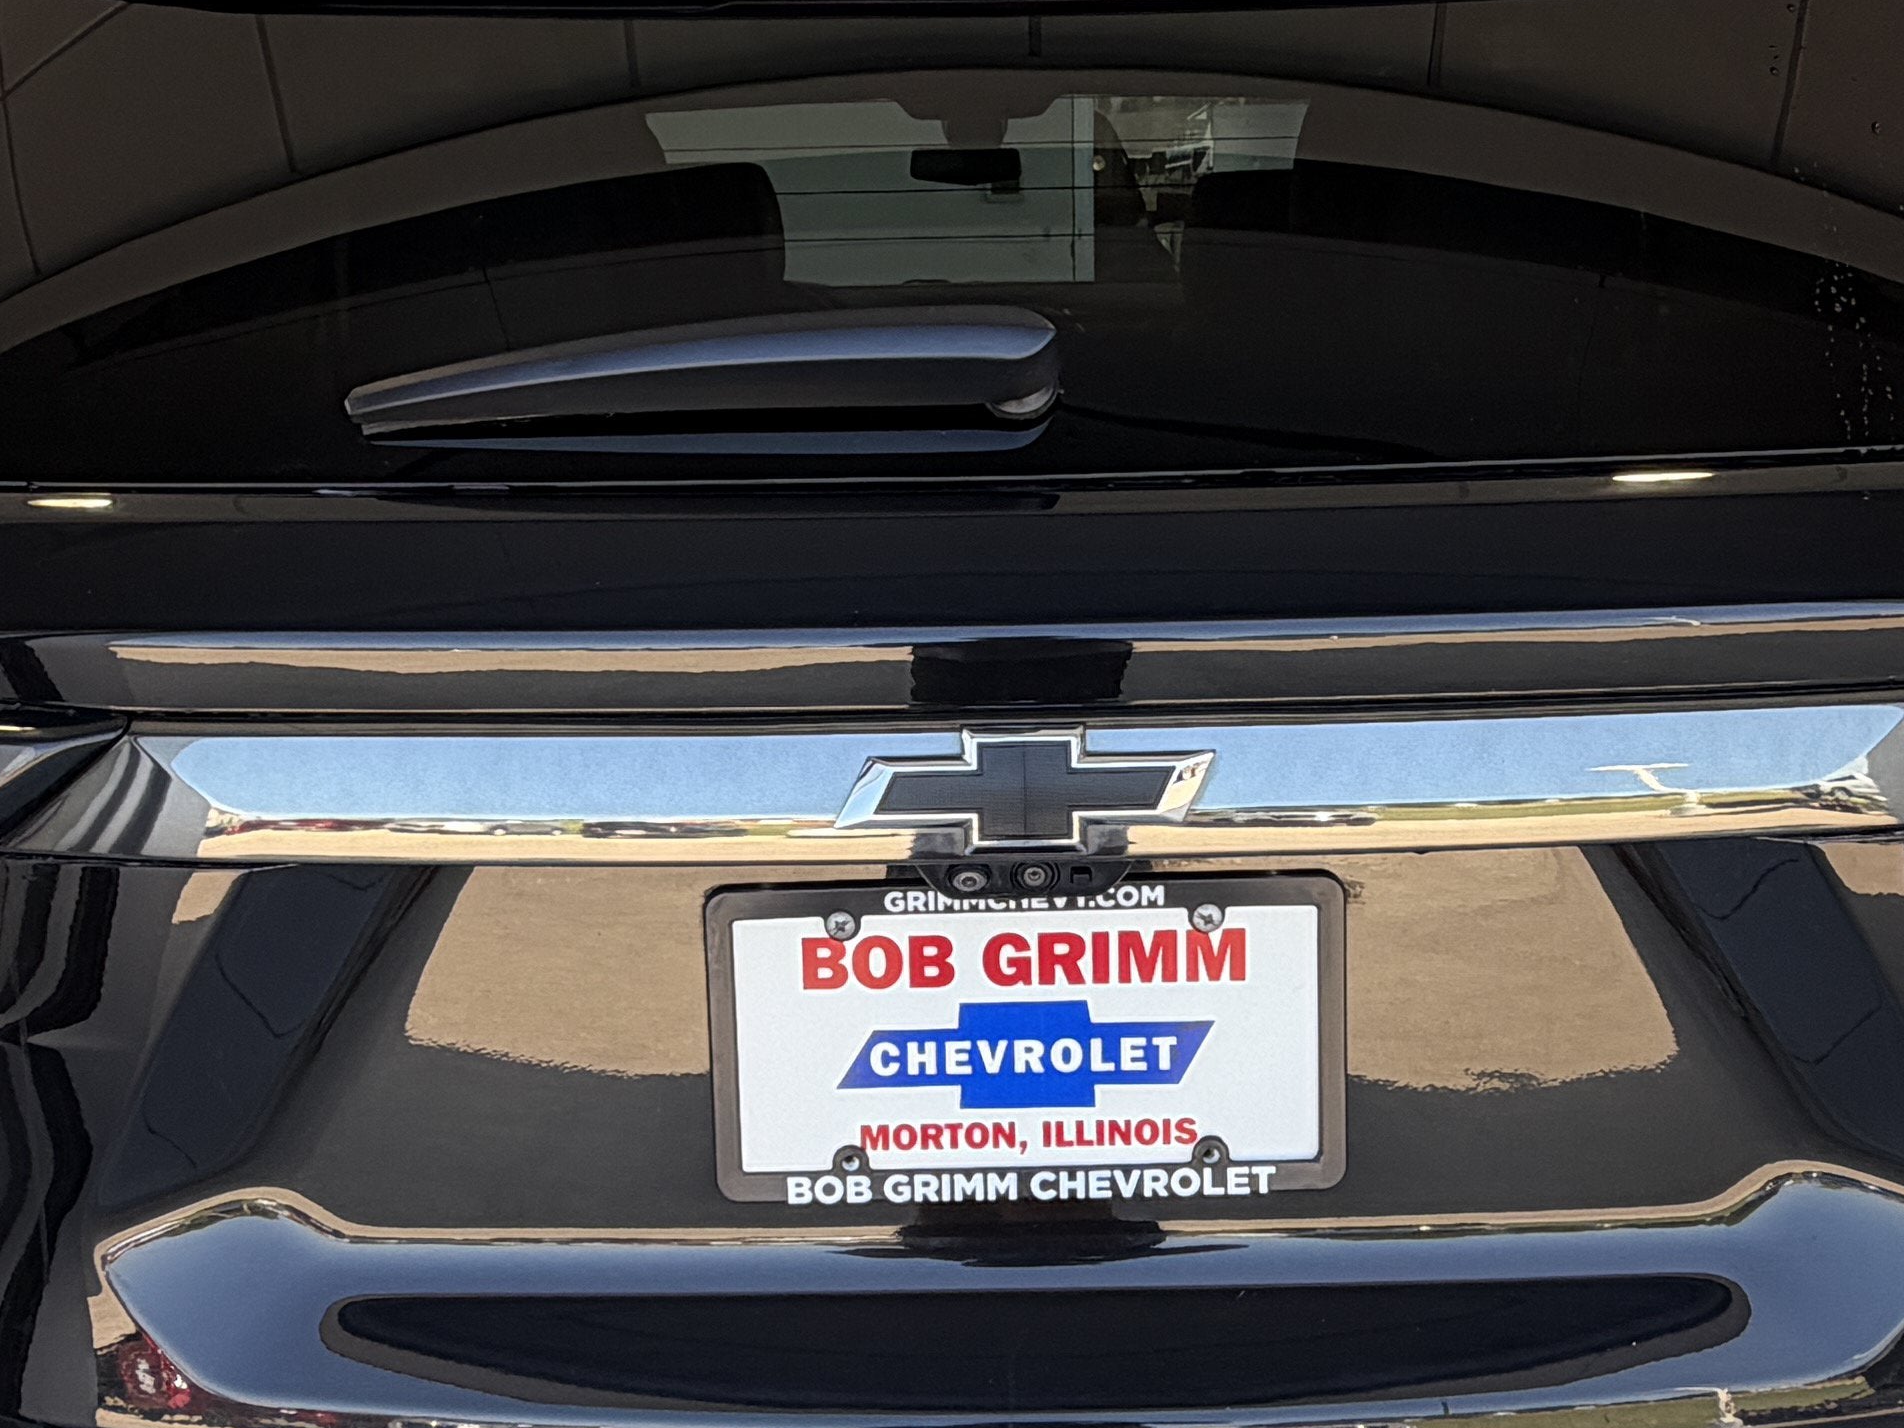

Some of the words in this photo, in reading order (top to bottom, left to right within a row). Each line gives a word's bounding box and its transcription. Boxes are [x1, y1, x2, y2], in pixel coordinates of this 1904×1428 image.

[800, 936, 955, 990] BOB
[982, 928, 1247, 986] GRIMM
[870, 1035, 1178, 1076] CHEVROLET
[859, 1121, 1028, 1154] MORTON,
[1041, 1117, 1198, 1147] ILLINOIS
[786, 1172, 873, 1205] BOB
[883, 1170, 1019, 1203] GRIMM
[1029, 1165, 1277, 1201] CHEVROLET
